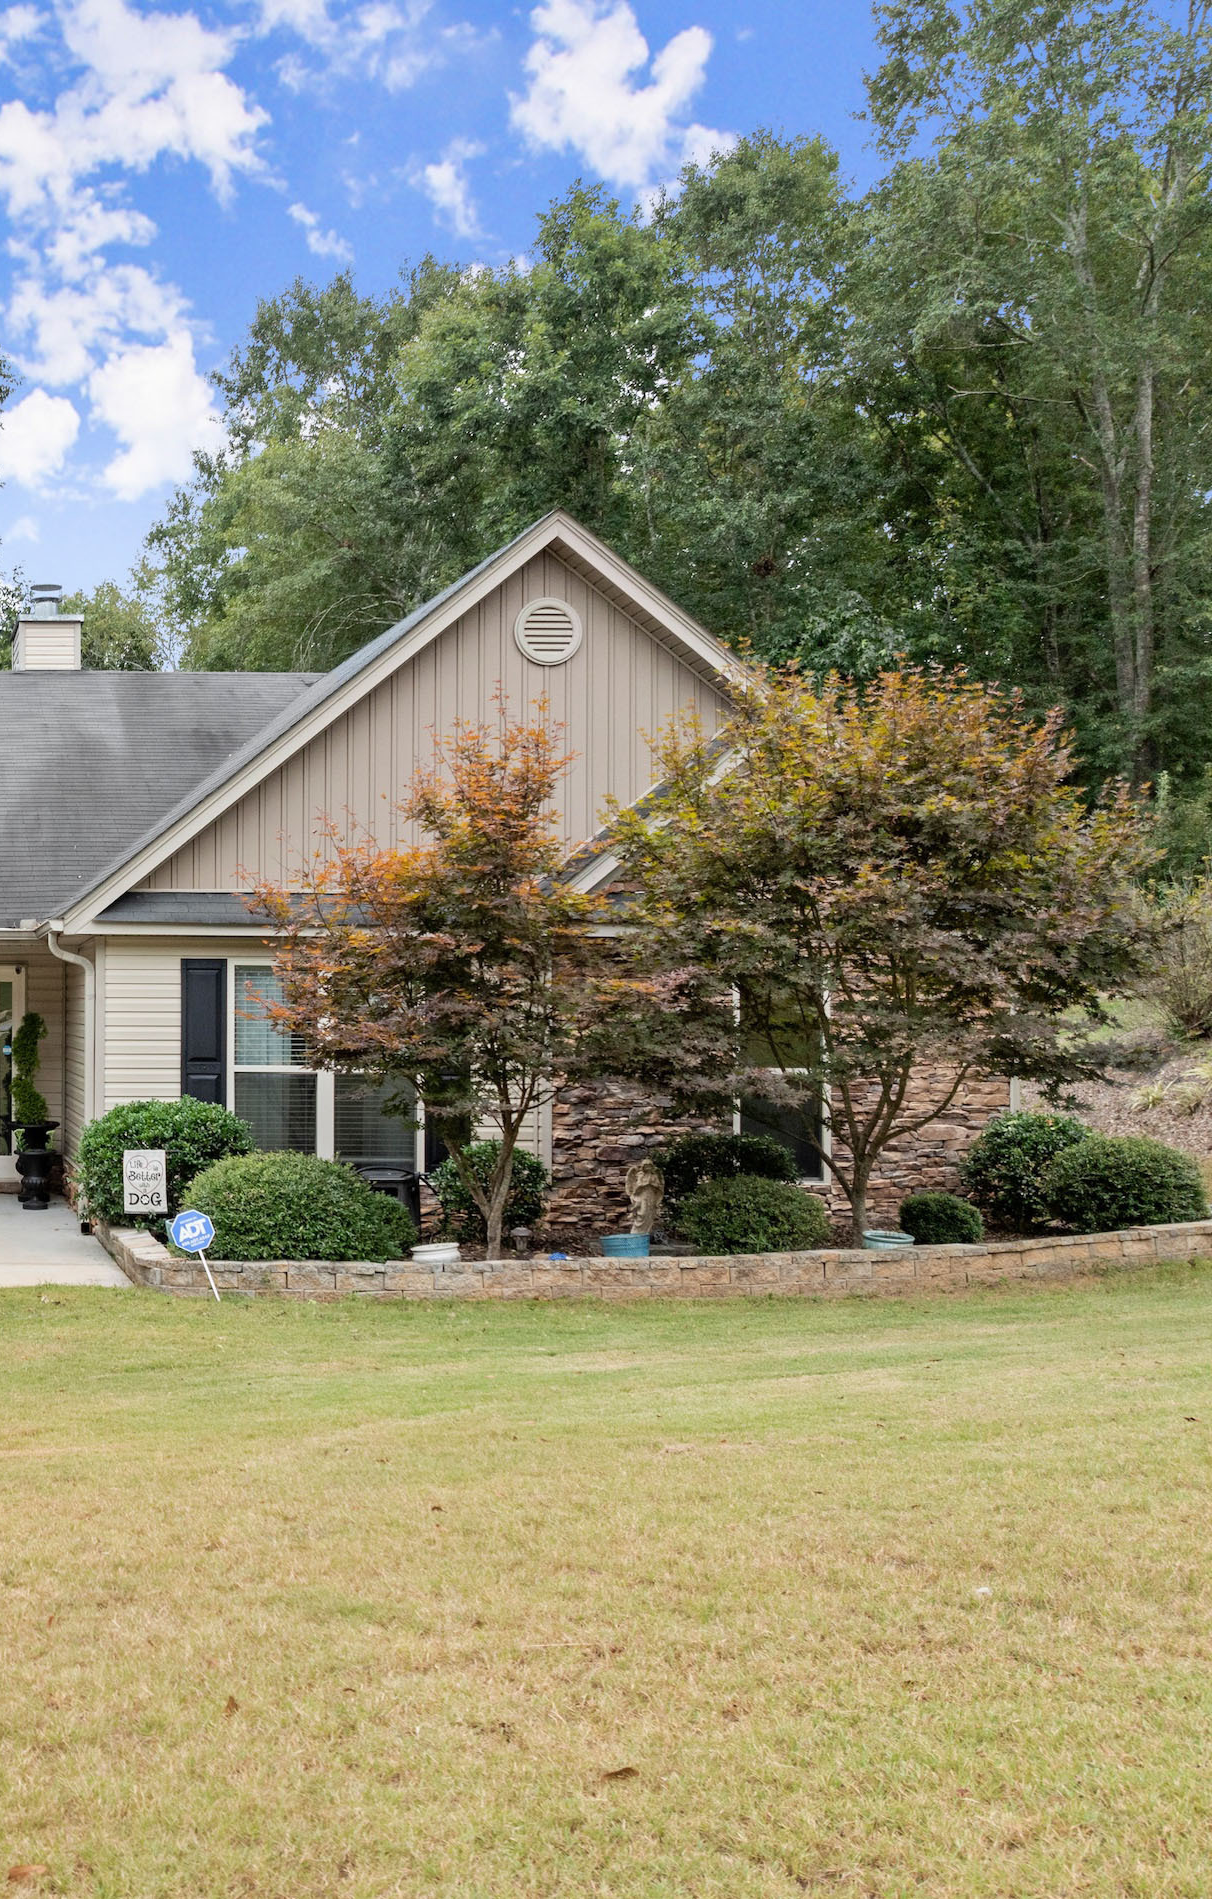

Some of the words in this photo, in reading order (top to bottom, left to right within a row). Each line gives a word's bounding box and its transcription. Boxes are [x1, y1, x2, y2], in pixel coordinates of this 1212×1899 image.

[128, 1170, 161, 1182] Better
[128, 1192, 162, 1206] DOG
[179, 1218, 206, 1242] ADT
